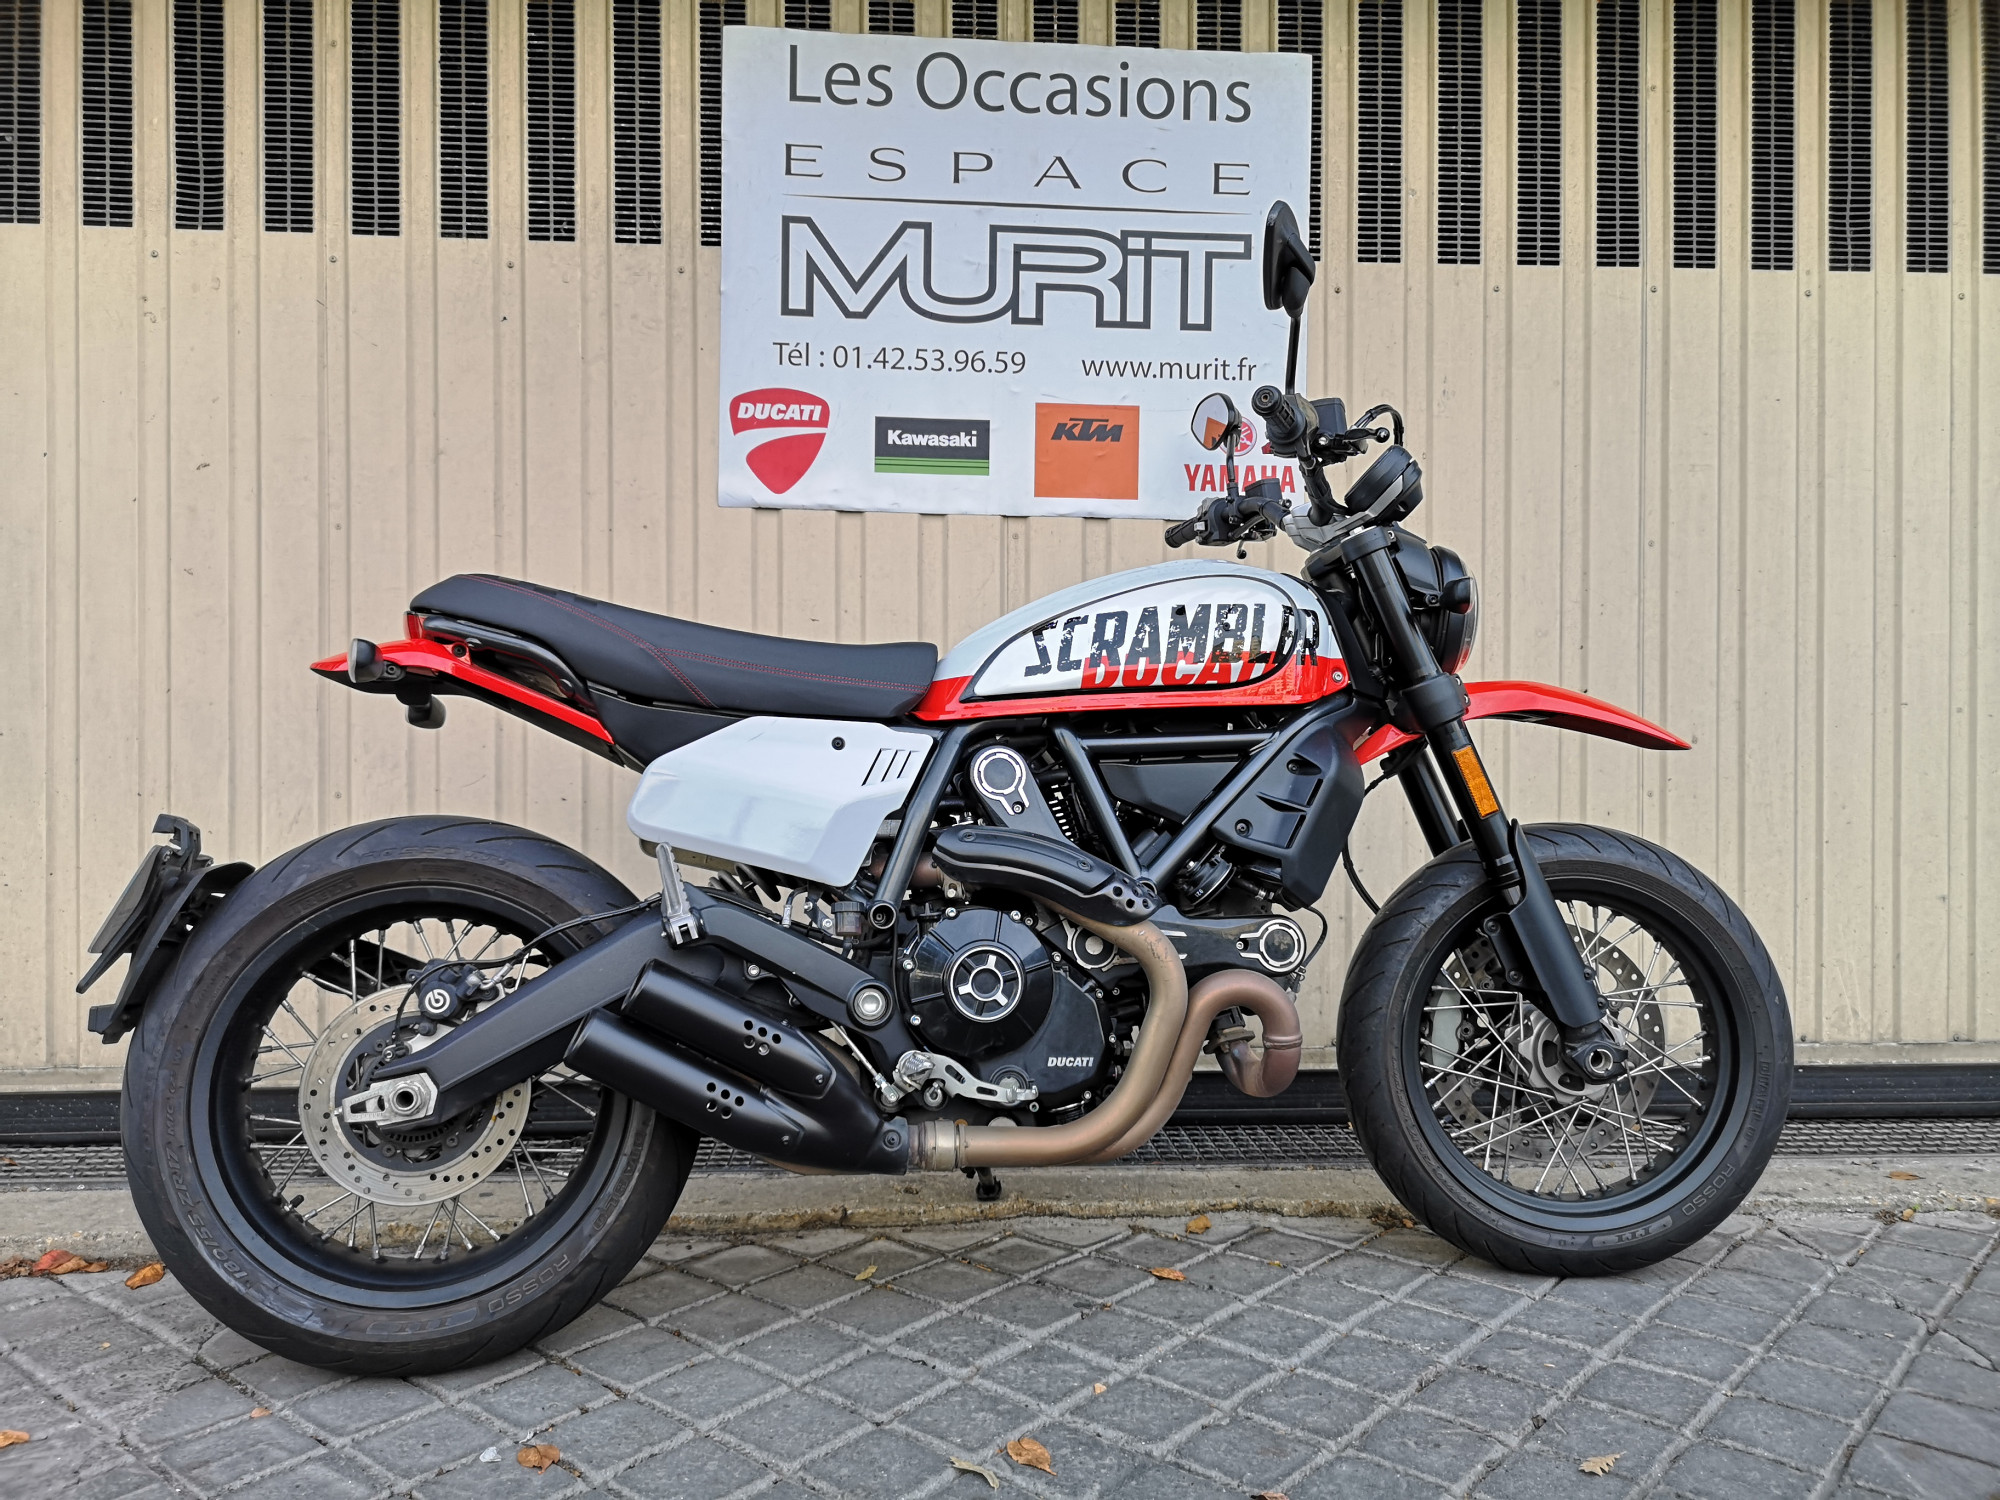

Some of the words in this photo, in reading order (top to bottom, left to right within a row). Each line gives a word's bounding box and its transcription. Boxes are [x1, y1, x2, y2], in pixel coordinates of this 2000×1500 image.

[789, 44, 894, 108] Les
[917, 52, 1252, 123] Occasions
[784, 143, 1251, 196] ESPACE
[772, 341, 810, 367] Tél
[832, 345, 1026, 375] 01.42.53.96.59
[1081, 357, 1257, 381] www.murit.fr
[737, 402, 823, 422] DUCATI
[887, 429, 978, 448] Kawasaki
[1051, 417, 1124, 443] KTM
[1047, 1057, 1094, 1067] DUCATI
[1681, 1163, 1736, 1217] ROSSO
[187, 1210, 248, 1280] 180/55
[487, 1253, 571, 1313] ROSSO
